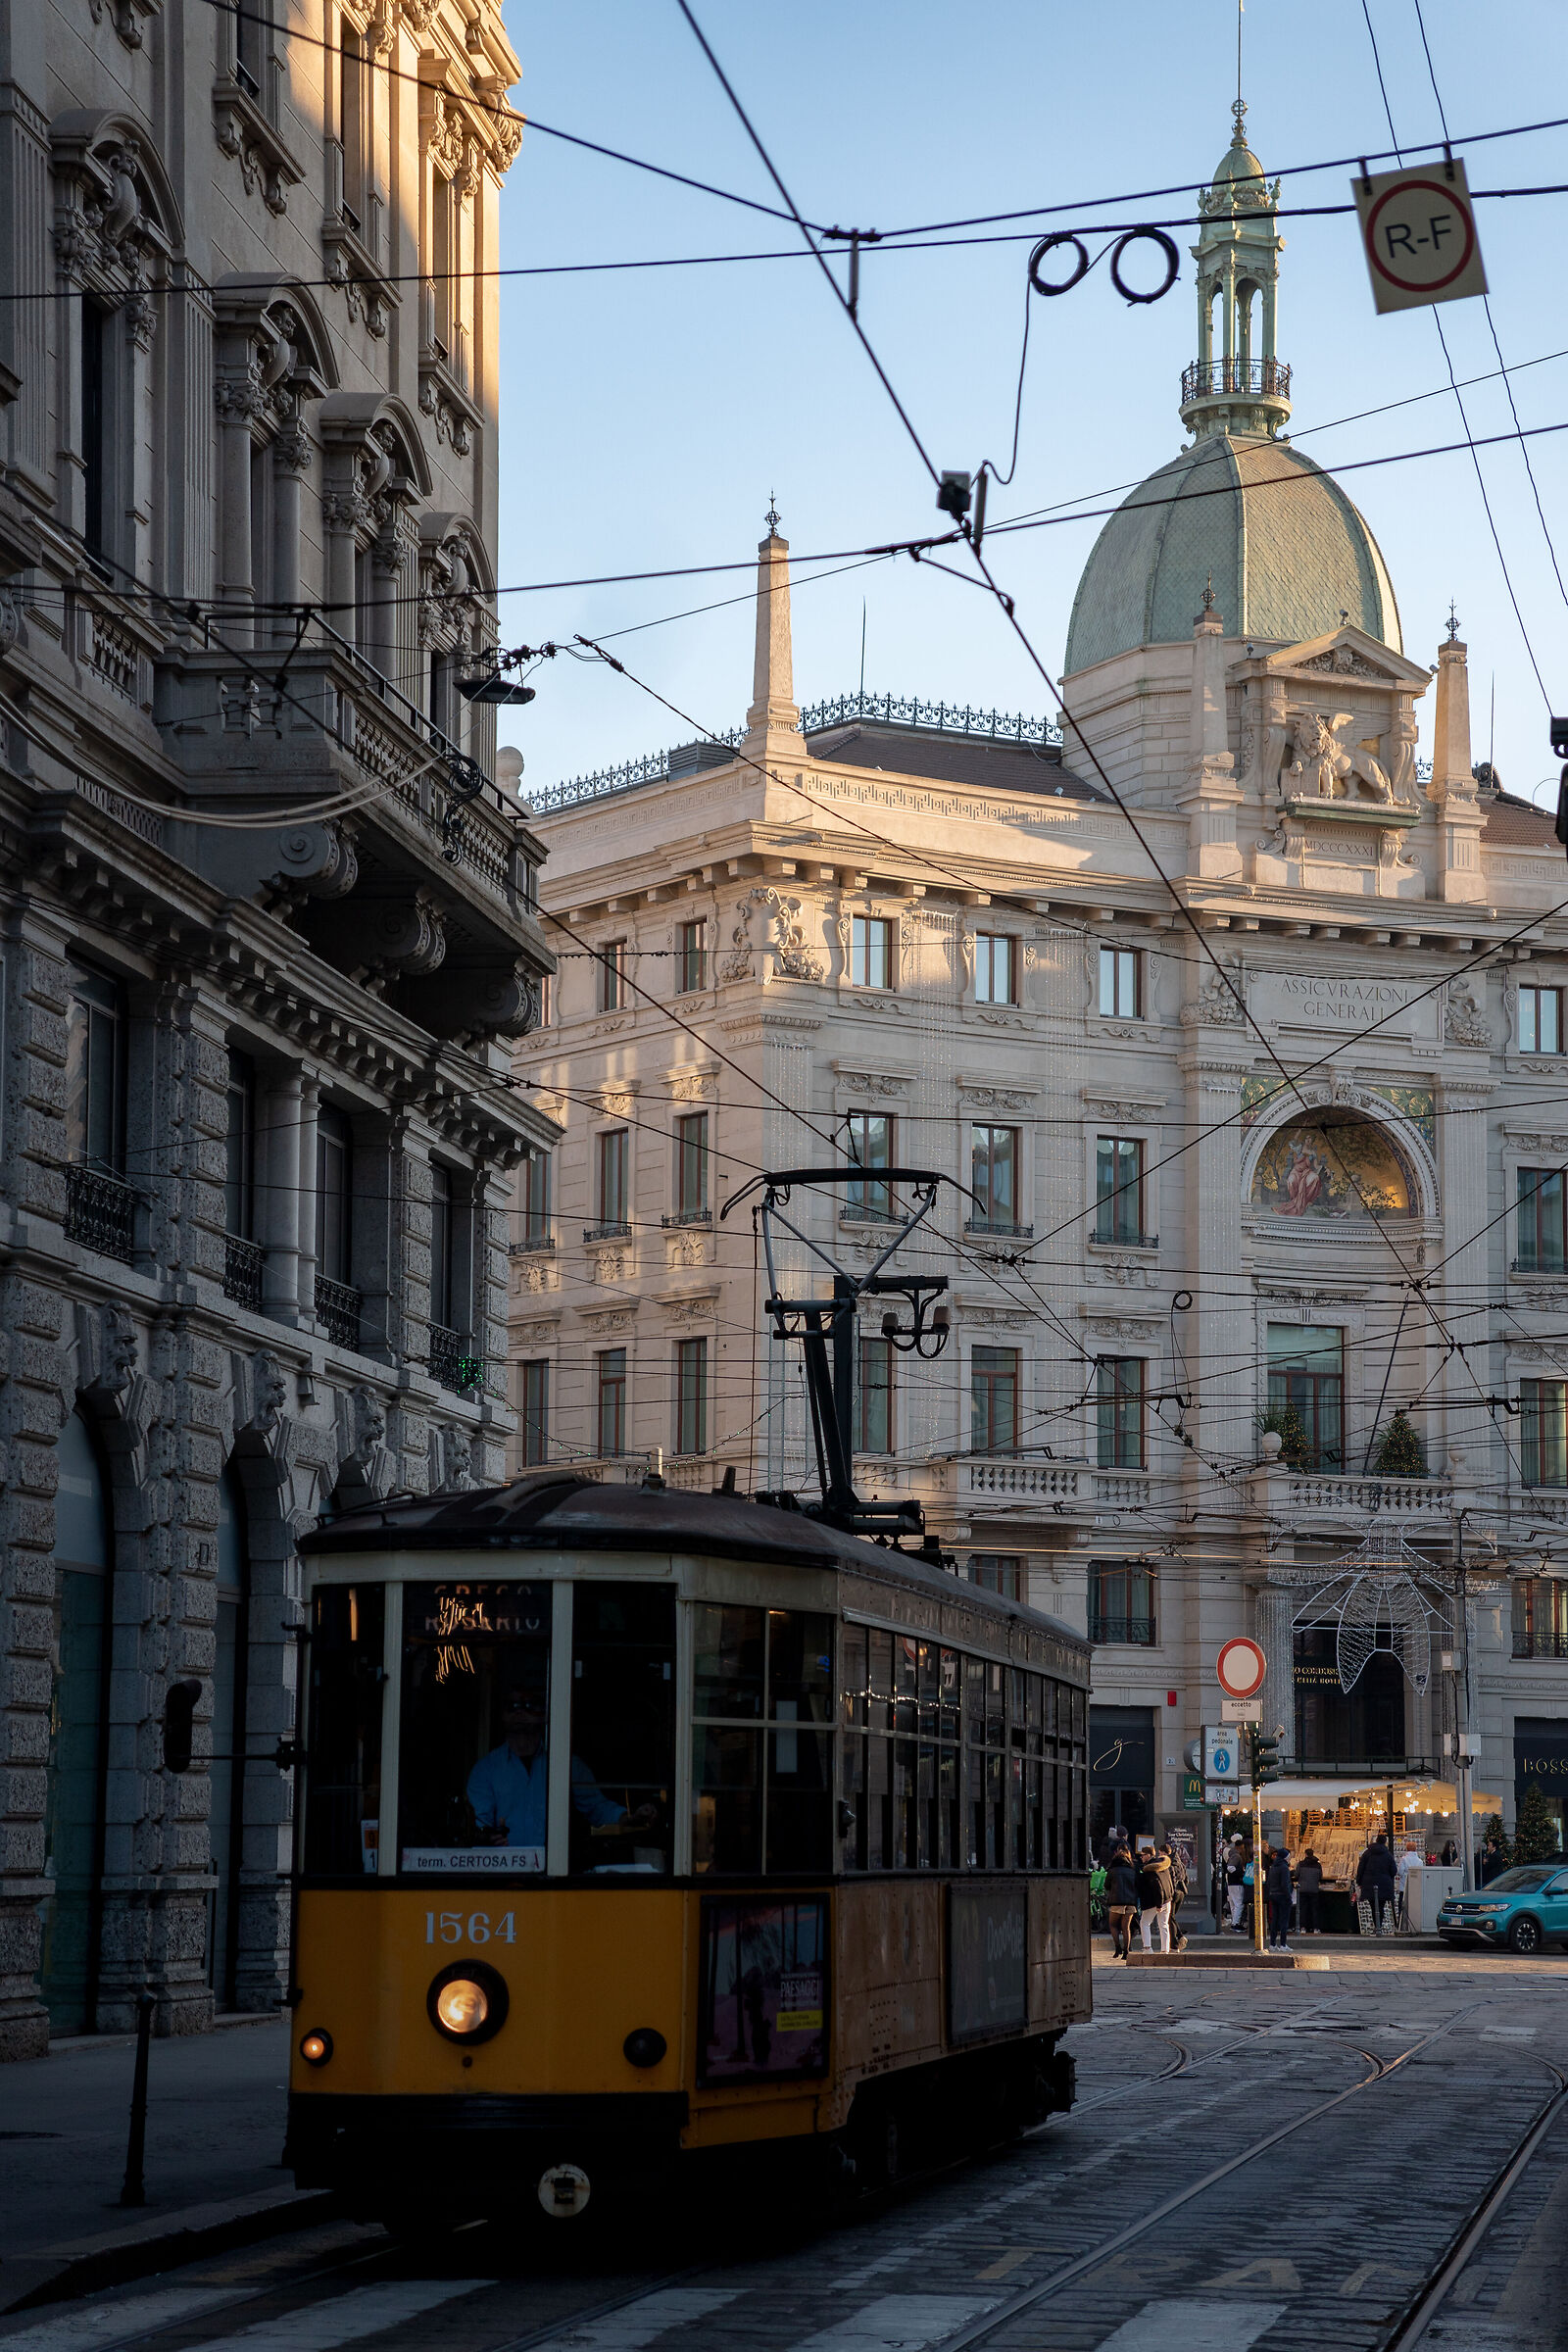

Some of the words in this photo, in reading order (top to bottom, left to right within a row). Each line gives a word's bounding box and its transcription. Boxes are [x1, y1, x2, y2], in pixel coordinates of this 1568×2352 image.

[1385, 215, 1450, 259] R-F
[1304, 841, 1373, 857] MDCCCXXXI
[1281, 979, 1408, 1004] ASSICVRAZIONI
[1303, 1001, 1385, 1021] GENERALI
[1524, 1758, 1568, 1775] BOSS
[417, 1856, 447, 1868] term.
[450, 1855, 509, 1868] CERTOSA
[511, 1855, 527, 1868] FS
[425, 1911, 518, 1944] 1564
